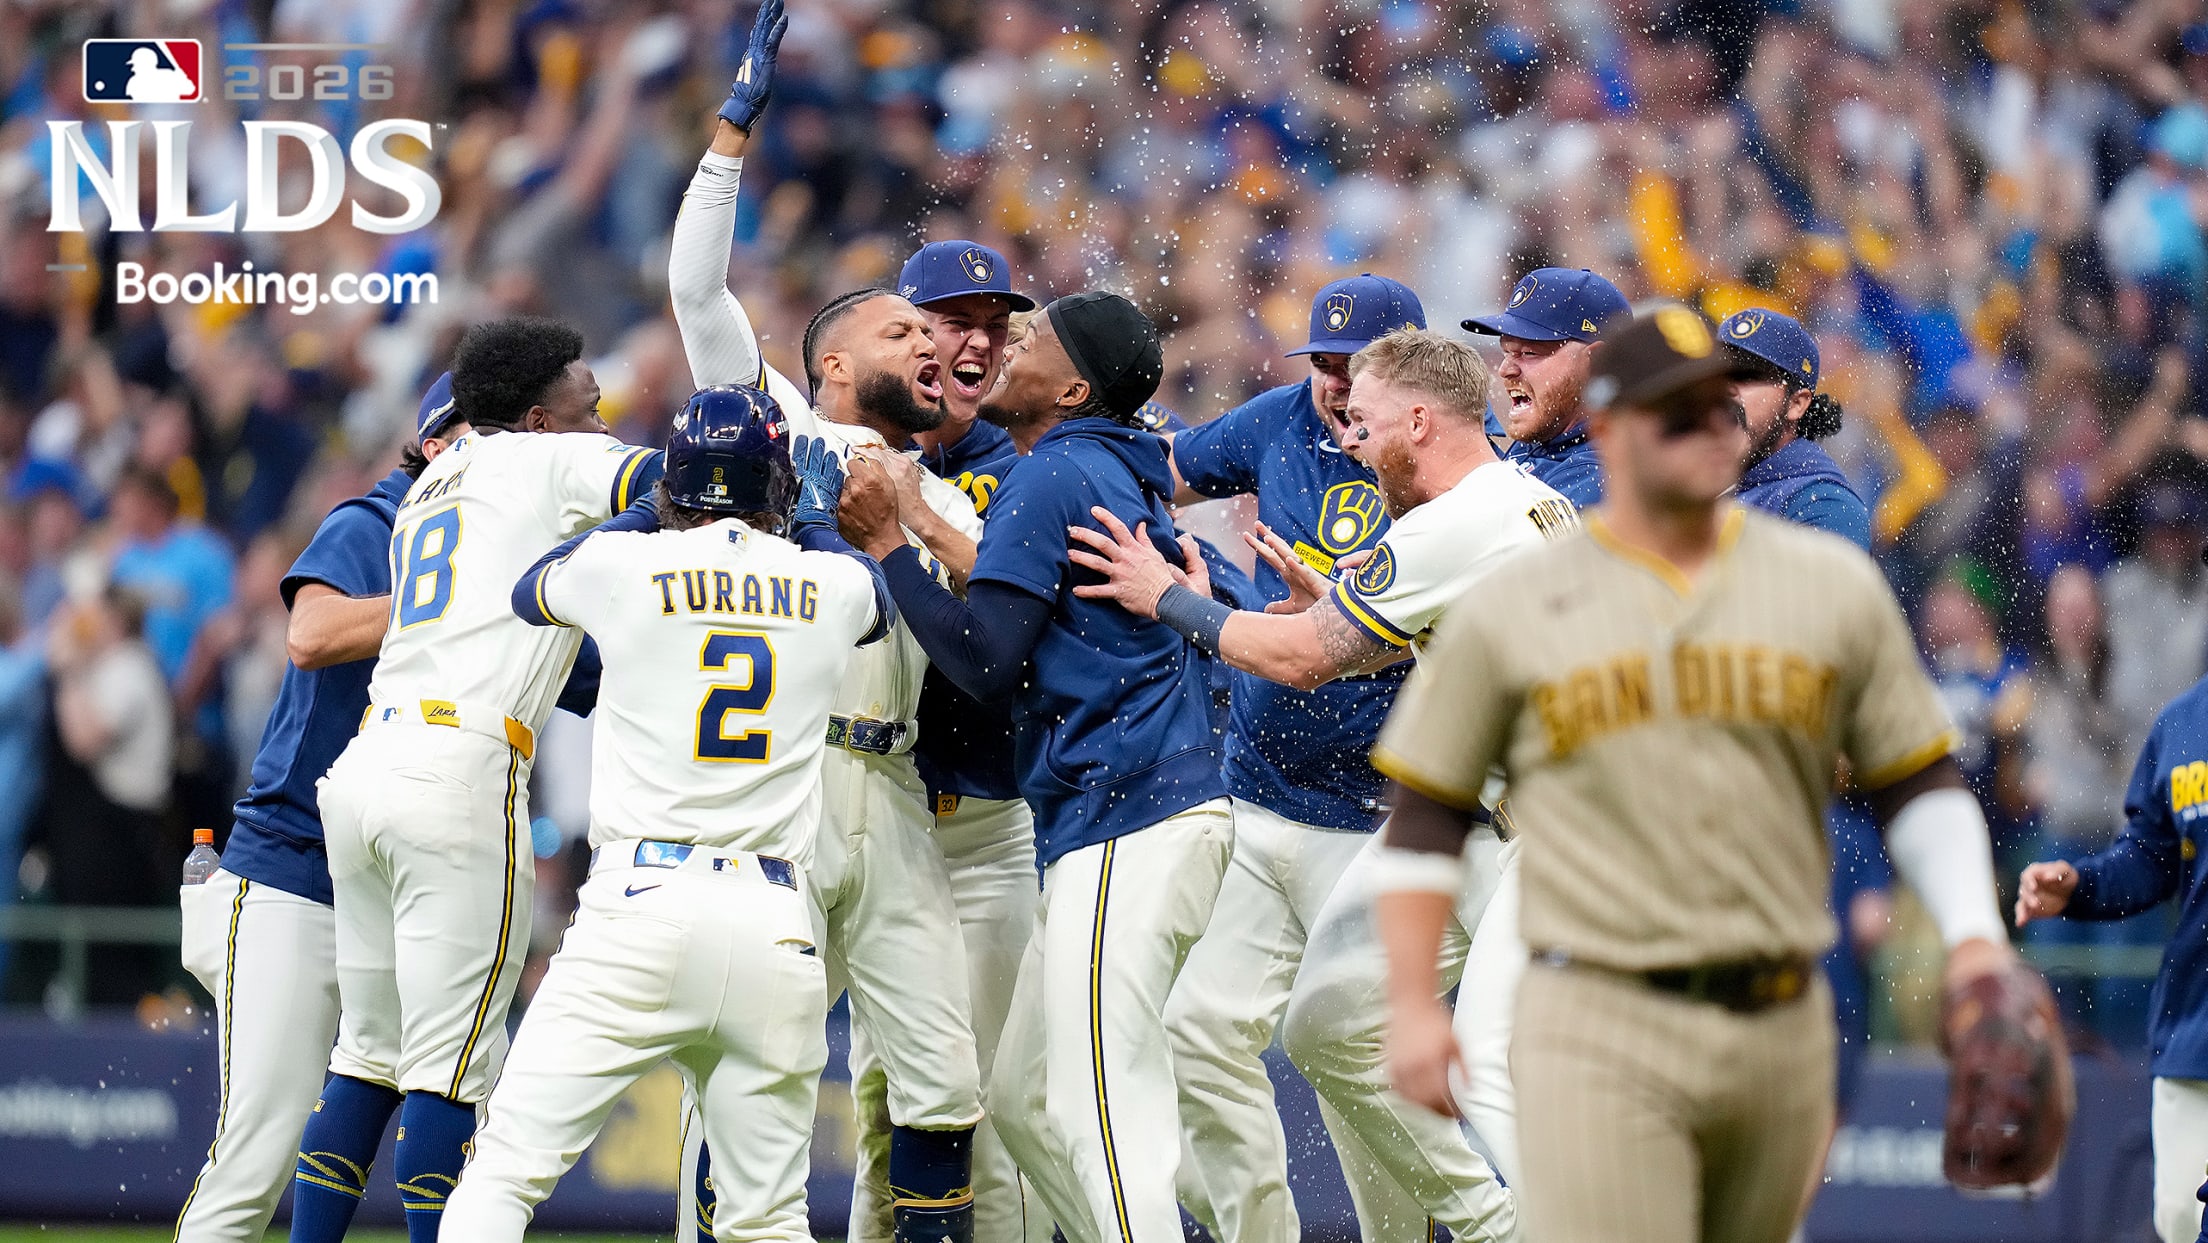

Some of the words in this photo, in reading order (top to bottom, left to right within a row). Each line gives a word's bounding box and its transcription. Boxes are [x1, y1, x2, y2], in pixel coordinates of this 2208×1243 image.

[712, 467, 724, 484] 2
[384, 502, 464, 638] 18
[1293, 546, 1332, 571] BREWERS
[651, 569, 819, 624] TURANG
[427, 705, 457, 718] LARA
[693, 629, 777, 764] 2
[1530, 650, 1656, 757] SAN
[941, 798, 954, 813] 32
[2170, 760, 2208, 813] BR
